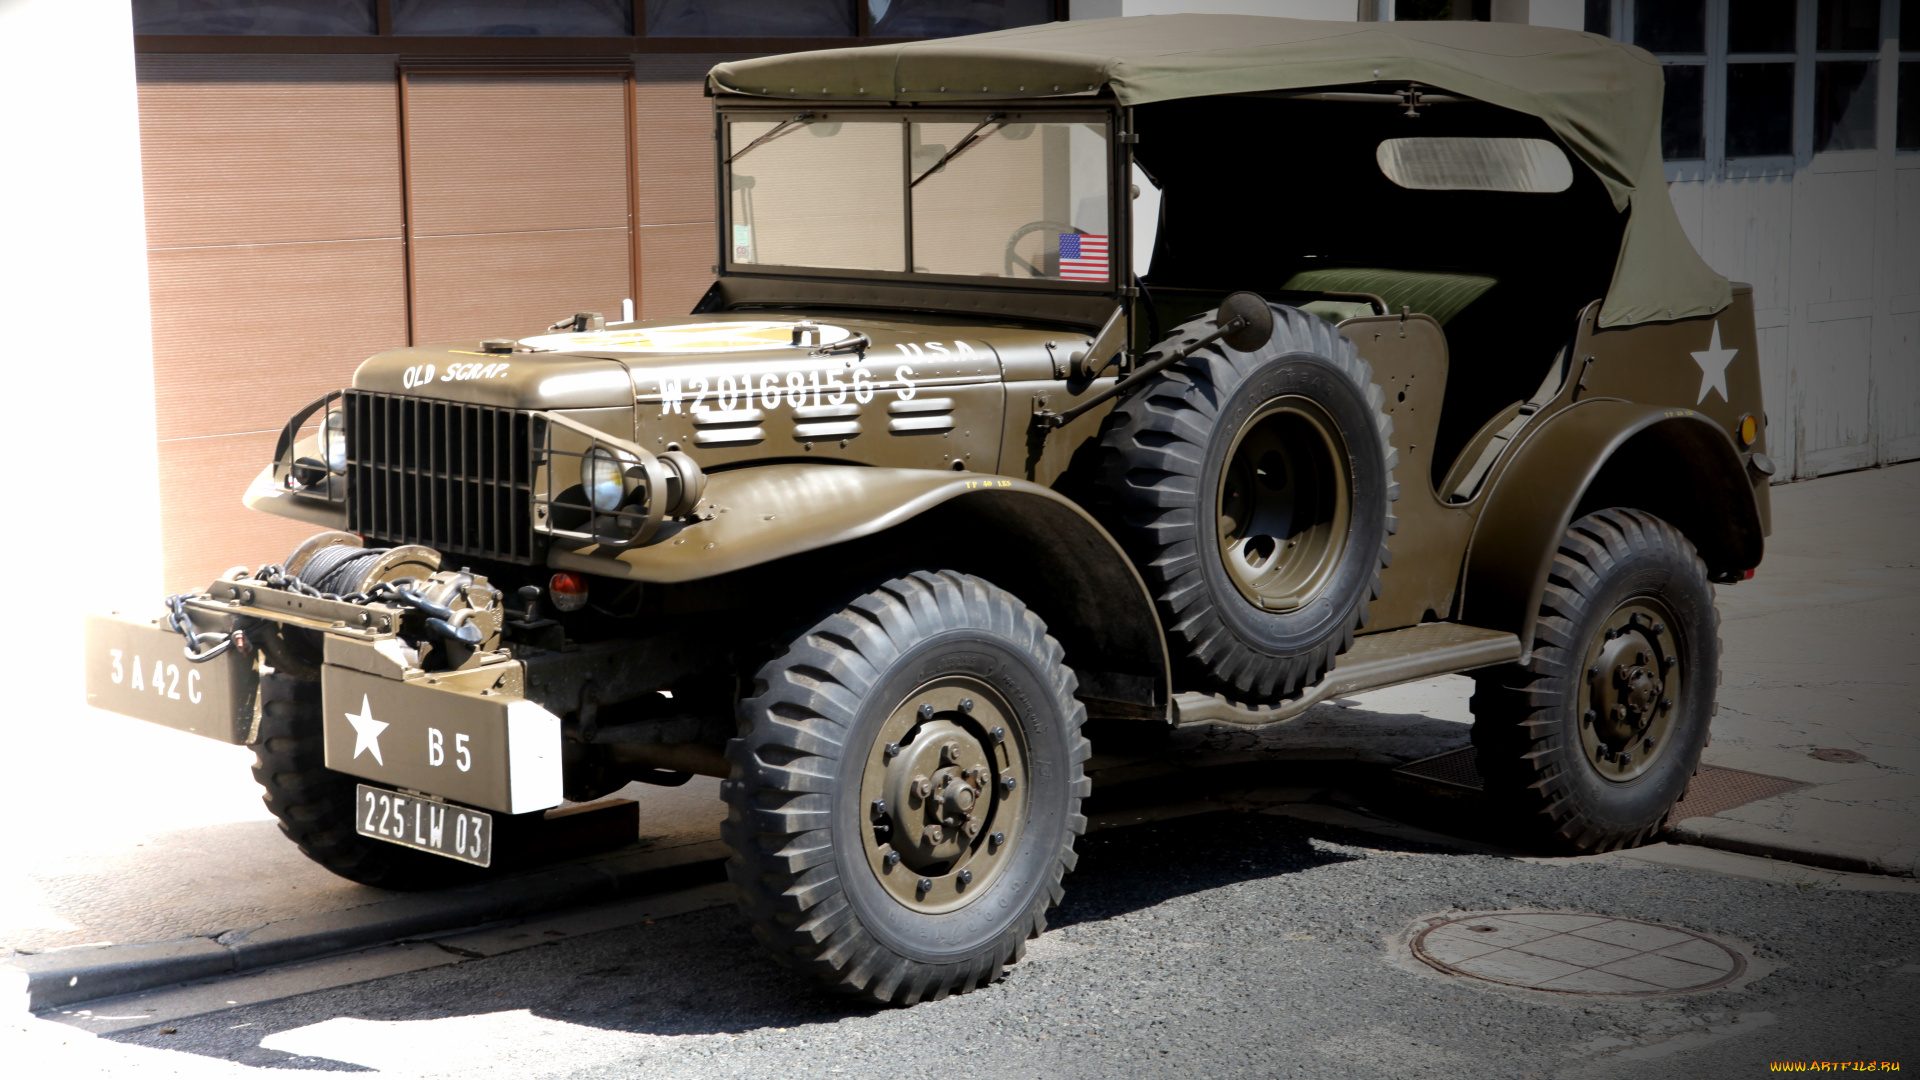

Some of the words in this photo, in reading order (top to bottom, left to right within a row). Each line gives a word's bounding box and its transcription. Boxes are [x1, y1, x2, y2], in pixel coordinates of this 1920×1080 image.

[403, 364, 436, 389] OLD
[440, 362, 510, 381] SCRAP.
[110, 649, 124, 684] 3
[131, 655, 145, 692] A
[152, 660, 181, 700] 42
[187, 669, 202, 705] C
[427, 727, 445, 767] B
[455, 733, 471, 773] 5
[364, 791, 405, 839] 225
[415, 808, 444, 849] LW
[454, 814, 482, 859] 03
